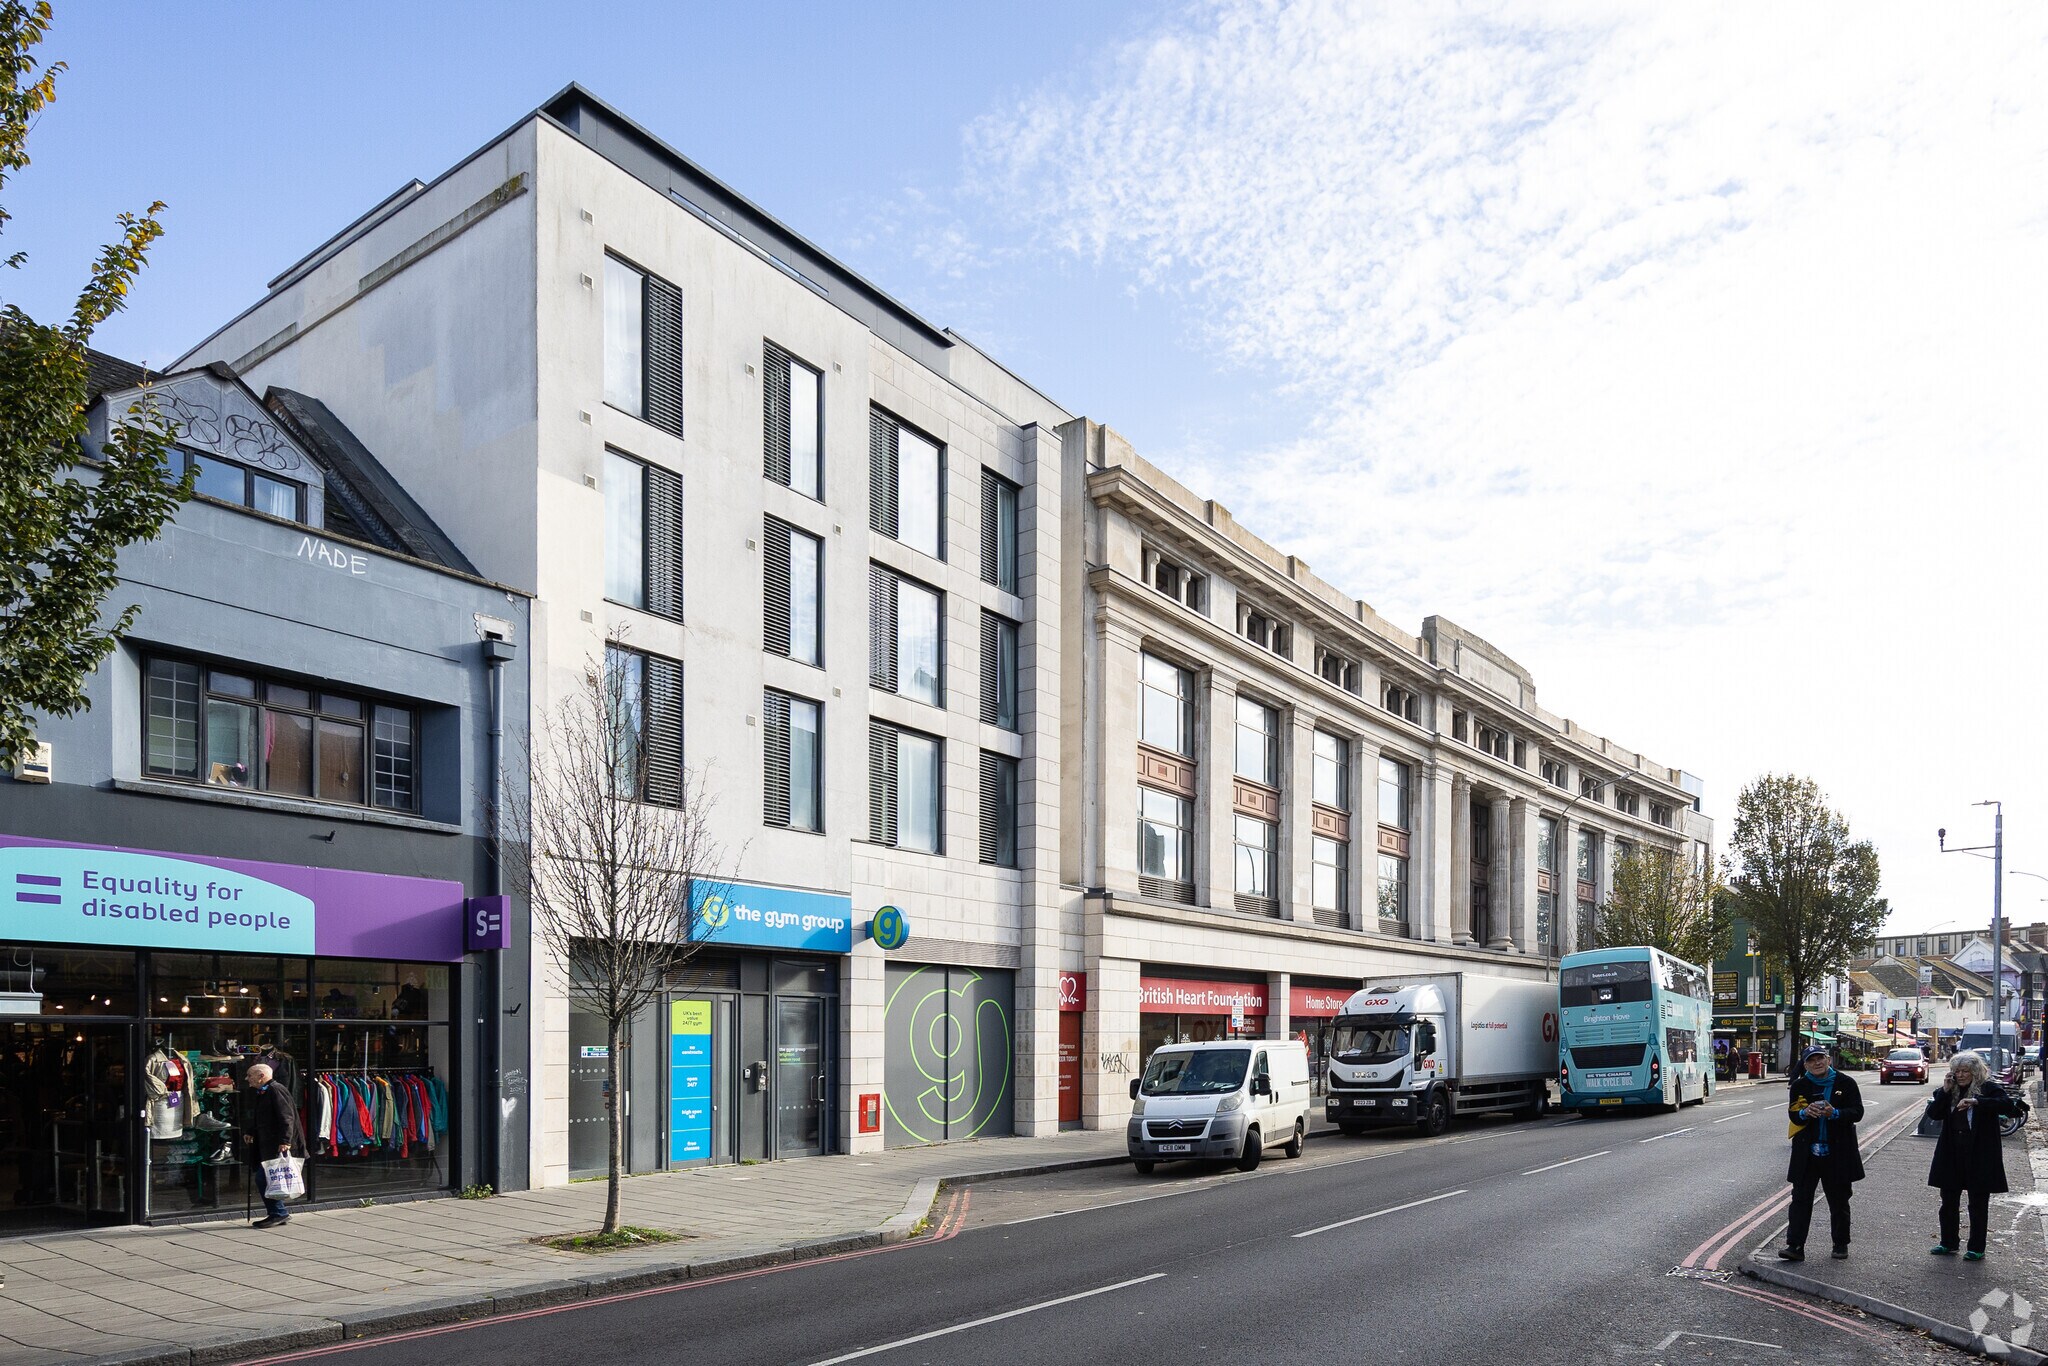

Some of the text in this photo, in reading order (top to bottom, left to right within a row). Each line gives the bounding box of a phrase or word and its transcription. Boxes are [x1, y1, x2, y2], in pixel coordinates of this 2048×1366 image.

[83, 870, 243, 901] Equality for
[82, 898, 291, 931] disabled people
[734, 904, 845, 934] the gym group
[1138, 987, 1173, 1004] British
[1176, 989, 1206, 1006] Heart
[1306, 995, 1343, 1010] Home Store
[1471, 1021, 1485, 1030] Logistics
[1583, 1015, 1610, 1023] Brighton
[1424, 1060, 1435, 1068] GXO
